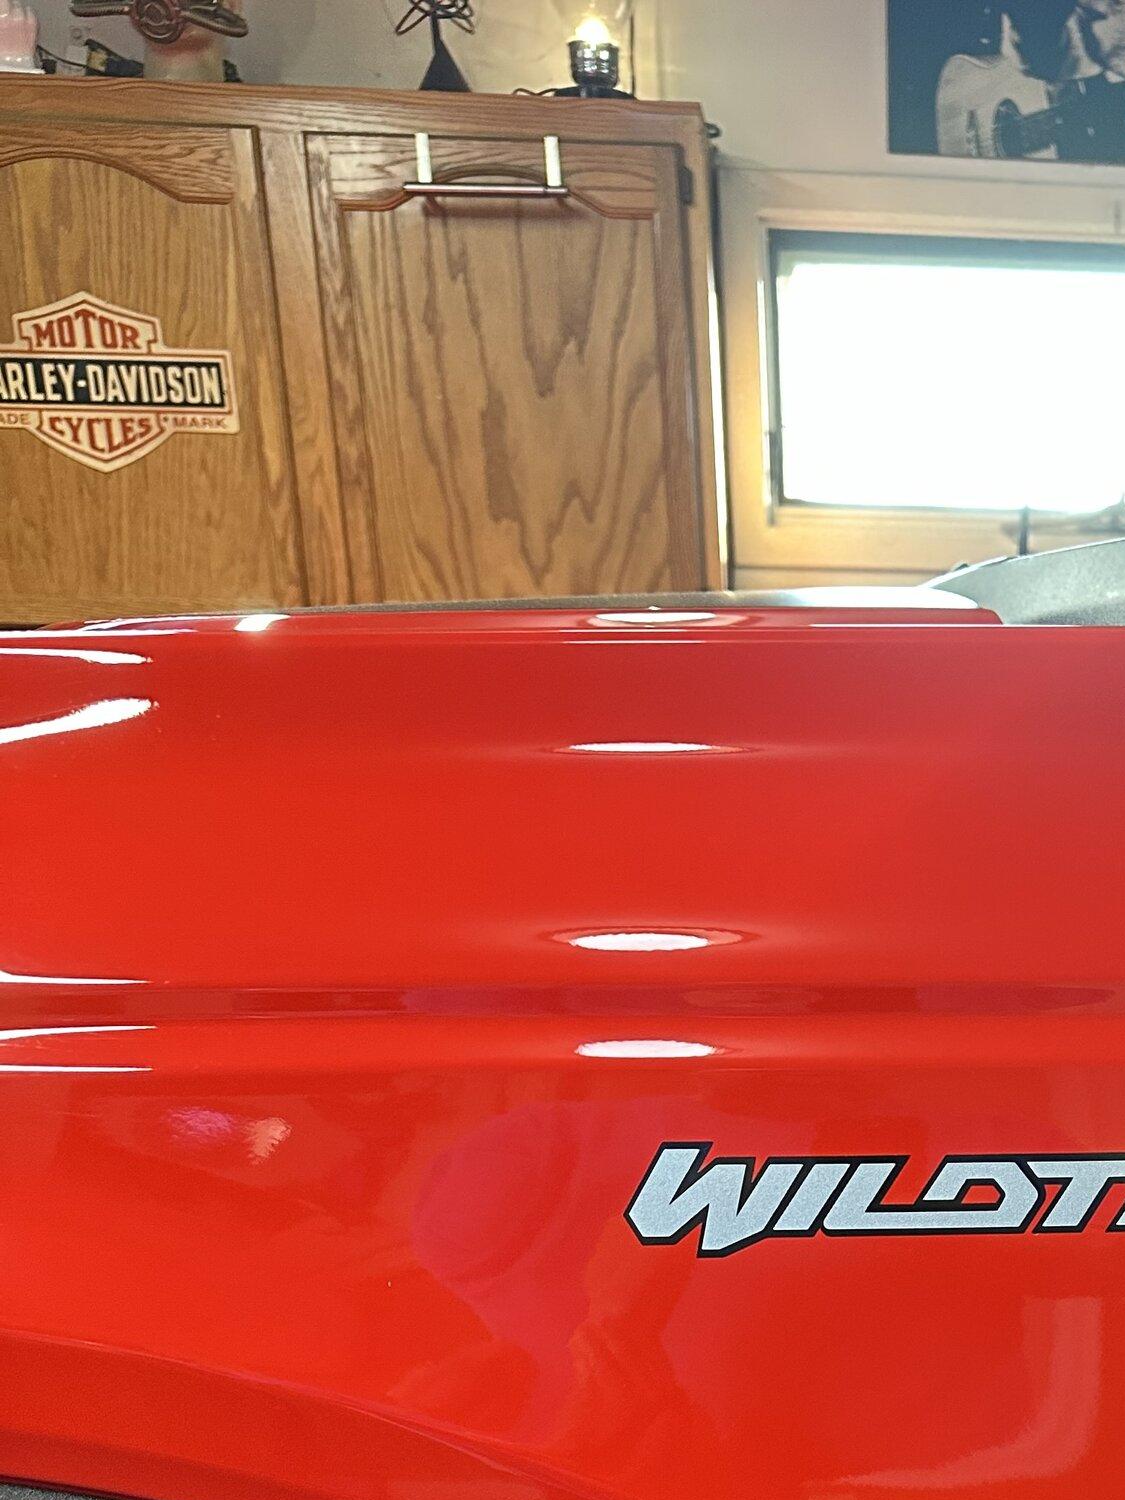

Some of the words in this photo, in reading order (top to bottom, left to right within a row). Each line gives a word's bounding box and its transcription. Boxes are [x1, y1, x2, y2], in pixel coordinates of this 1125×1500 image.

[32, 308, 141, 350] MOTOR
[49, 415, 151, 453] CYCLES
[173, 416, 227, 429] MARK
